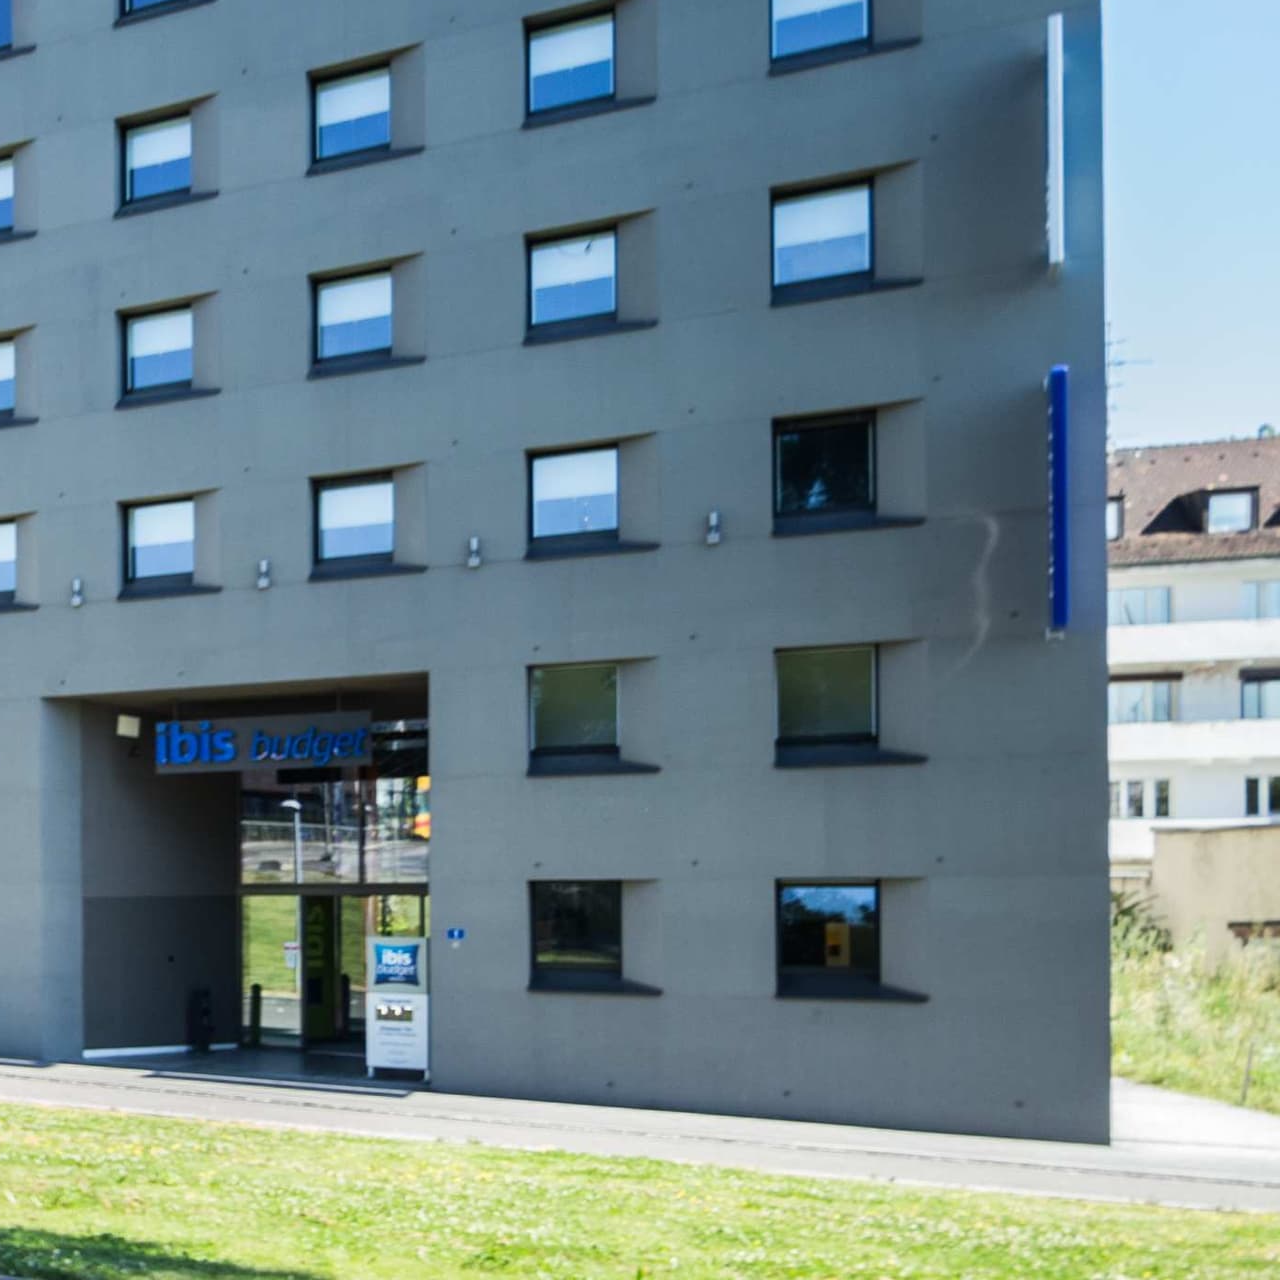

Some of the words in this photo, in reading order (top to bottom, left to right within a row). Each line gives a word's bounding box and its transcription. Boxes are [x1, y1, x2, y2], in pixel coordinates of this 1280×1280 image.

[155, 720, 236, 765] ibis
[249, 726, 368, 767] budget
[381, 949, 412, 966] ibis
